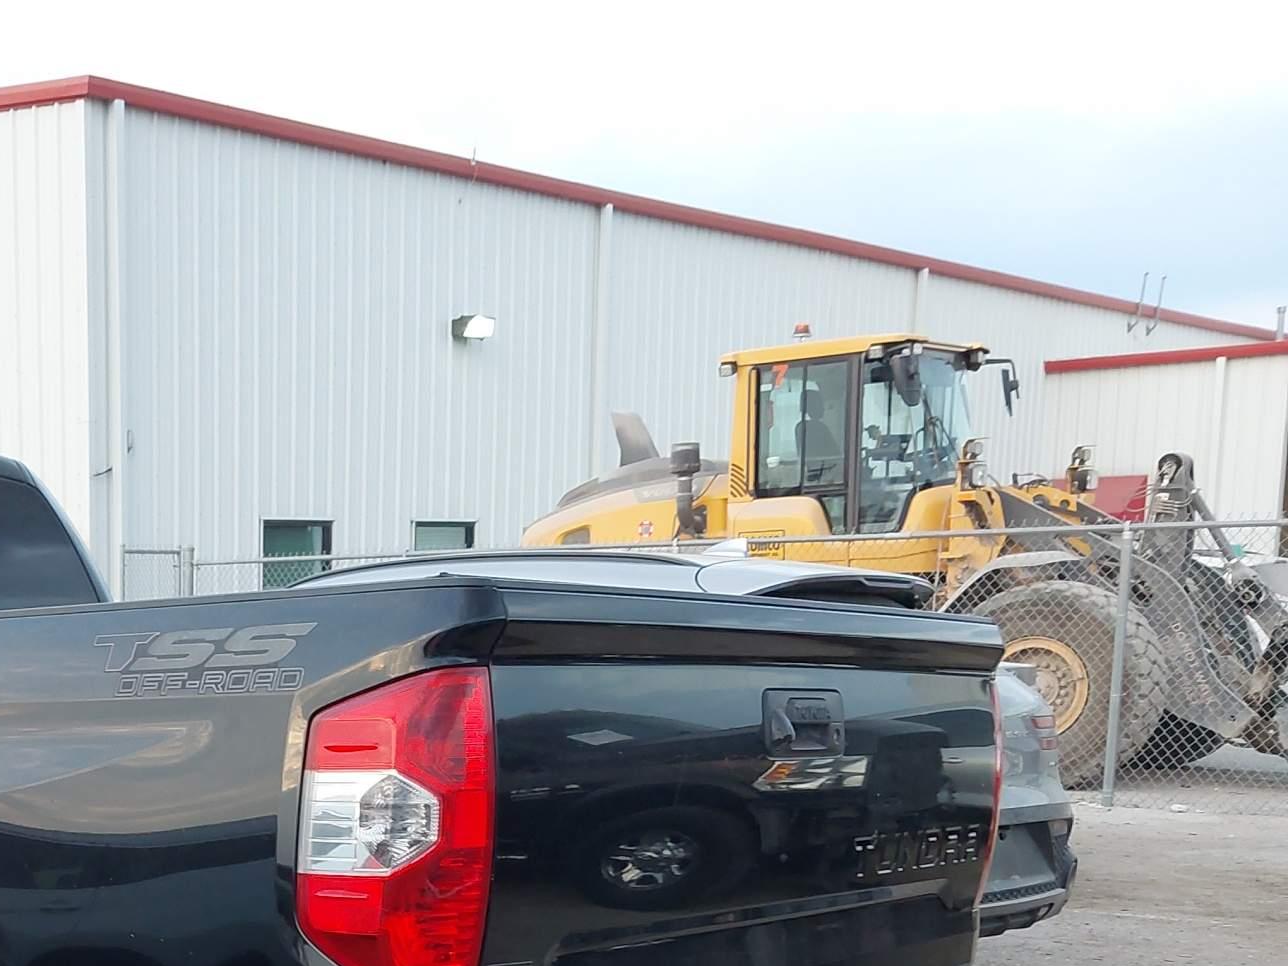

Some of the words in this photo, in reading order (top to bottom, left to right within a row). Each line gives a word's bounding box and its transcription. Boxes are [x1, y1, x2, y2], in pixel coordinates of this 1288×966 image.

[772, 364, 789, 388] 7
[94, 622, 318, 672] TSS
[114, 667, 305, 697] OFF-ROAD
[854, 824, 980, 878] TUNDRA
